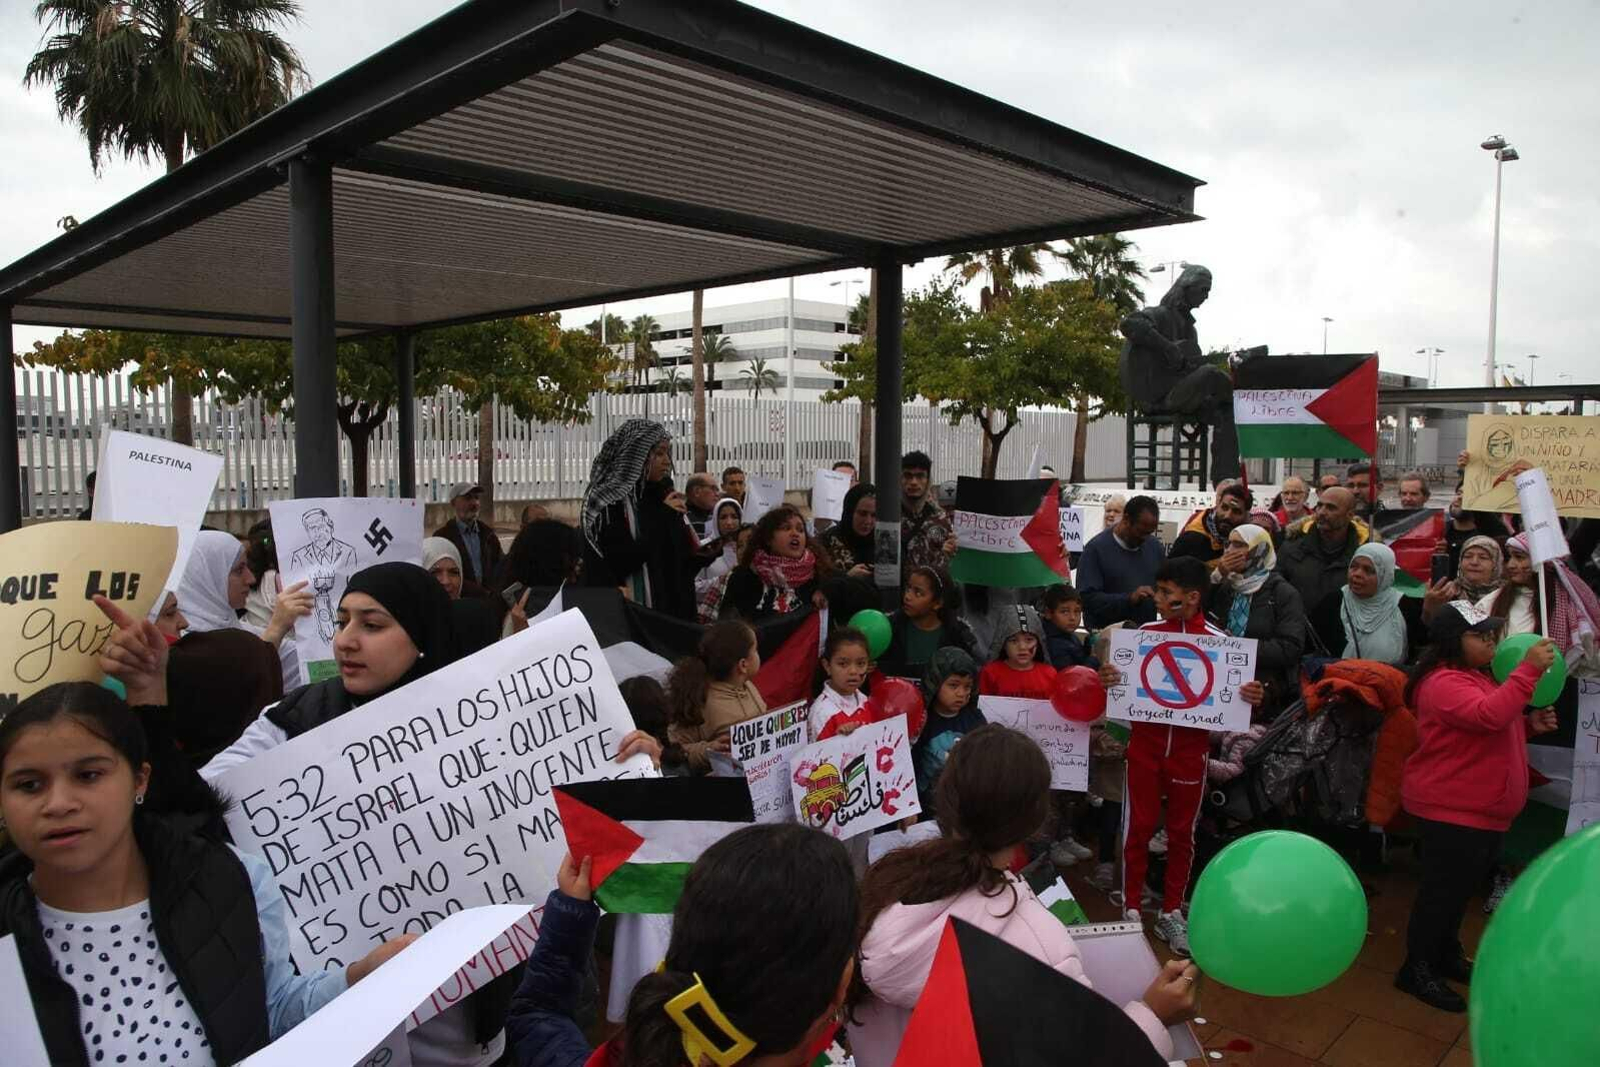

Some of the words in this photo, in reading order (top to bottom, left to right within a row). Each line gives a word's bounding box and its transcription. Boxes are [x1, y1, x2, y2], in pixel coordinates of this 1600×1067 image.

[129, 450, 193, 471] PALESTINA
[1551, 487, 1600, 505] MADR
[14, 607, 114, 683] gaz
[241, 764, 337, 838] 5:32
[341, 716, 437, 784] PARA
[436, 688, 498, 737] LOS
[497, 644, 593, 712] HIJOS
[262, 827, 310, 877] DE
[312, 772, 434, 852] ISRAEL
[509, 686, 597, 756] QUIEN
[279, 841, 383, 918] MATA
[393, 823, 421, 863] A
[426, 796, 475, 842] UN
[479, 728, 620, 821] INOCENTE
[299, 908, 348, 955] ES
[358, 861, 449, 928] COMO
[463, 834, 501, 876] SI
[517, 807, 562, 852] MA
